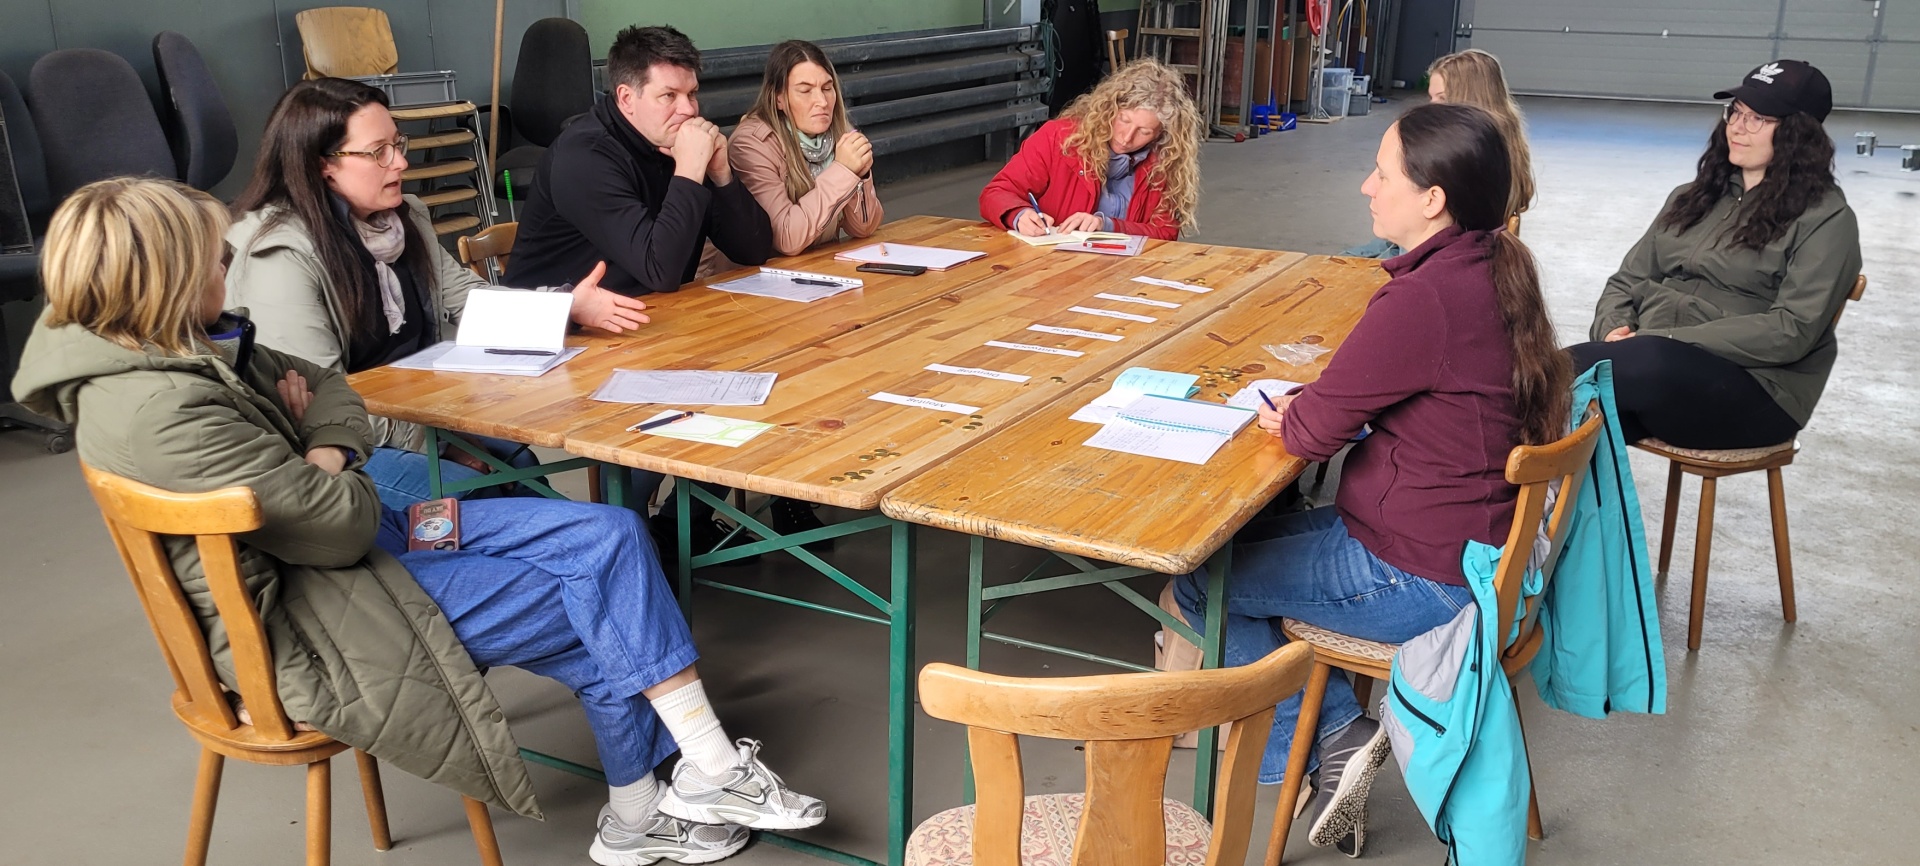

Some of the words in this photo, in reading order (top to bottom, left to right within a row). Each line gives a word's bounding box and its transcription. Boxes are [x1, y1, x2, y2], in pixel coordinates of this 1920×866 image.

[1051, 327, 1103, 337] Donnerstag
[1012, 344, 1058, 353] Mittwoch
[957, 368, 1001, 378] Dienstag
[906, 397, 947, 408] Montag
